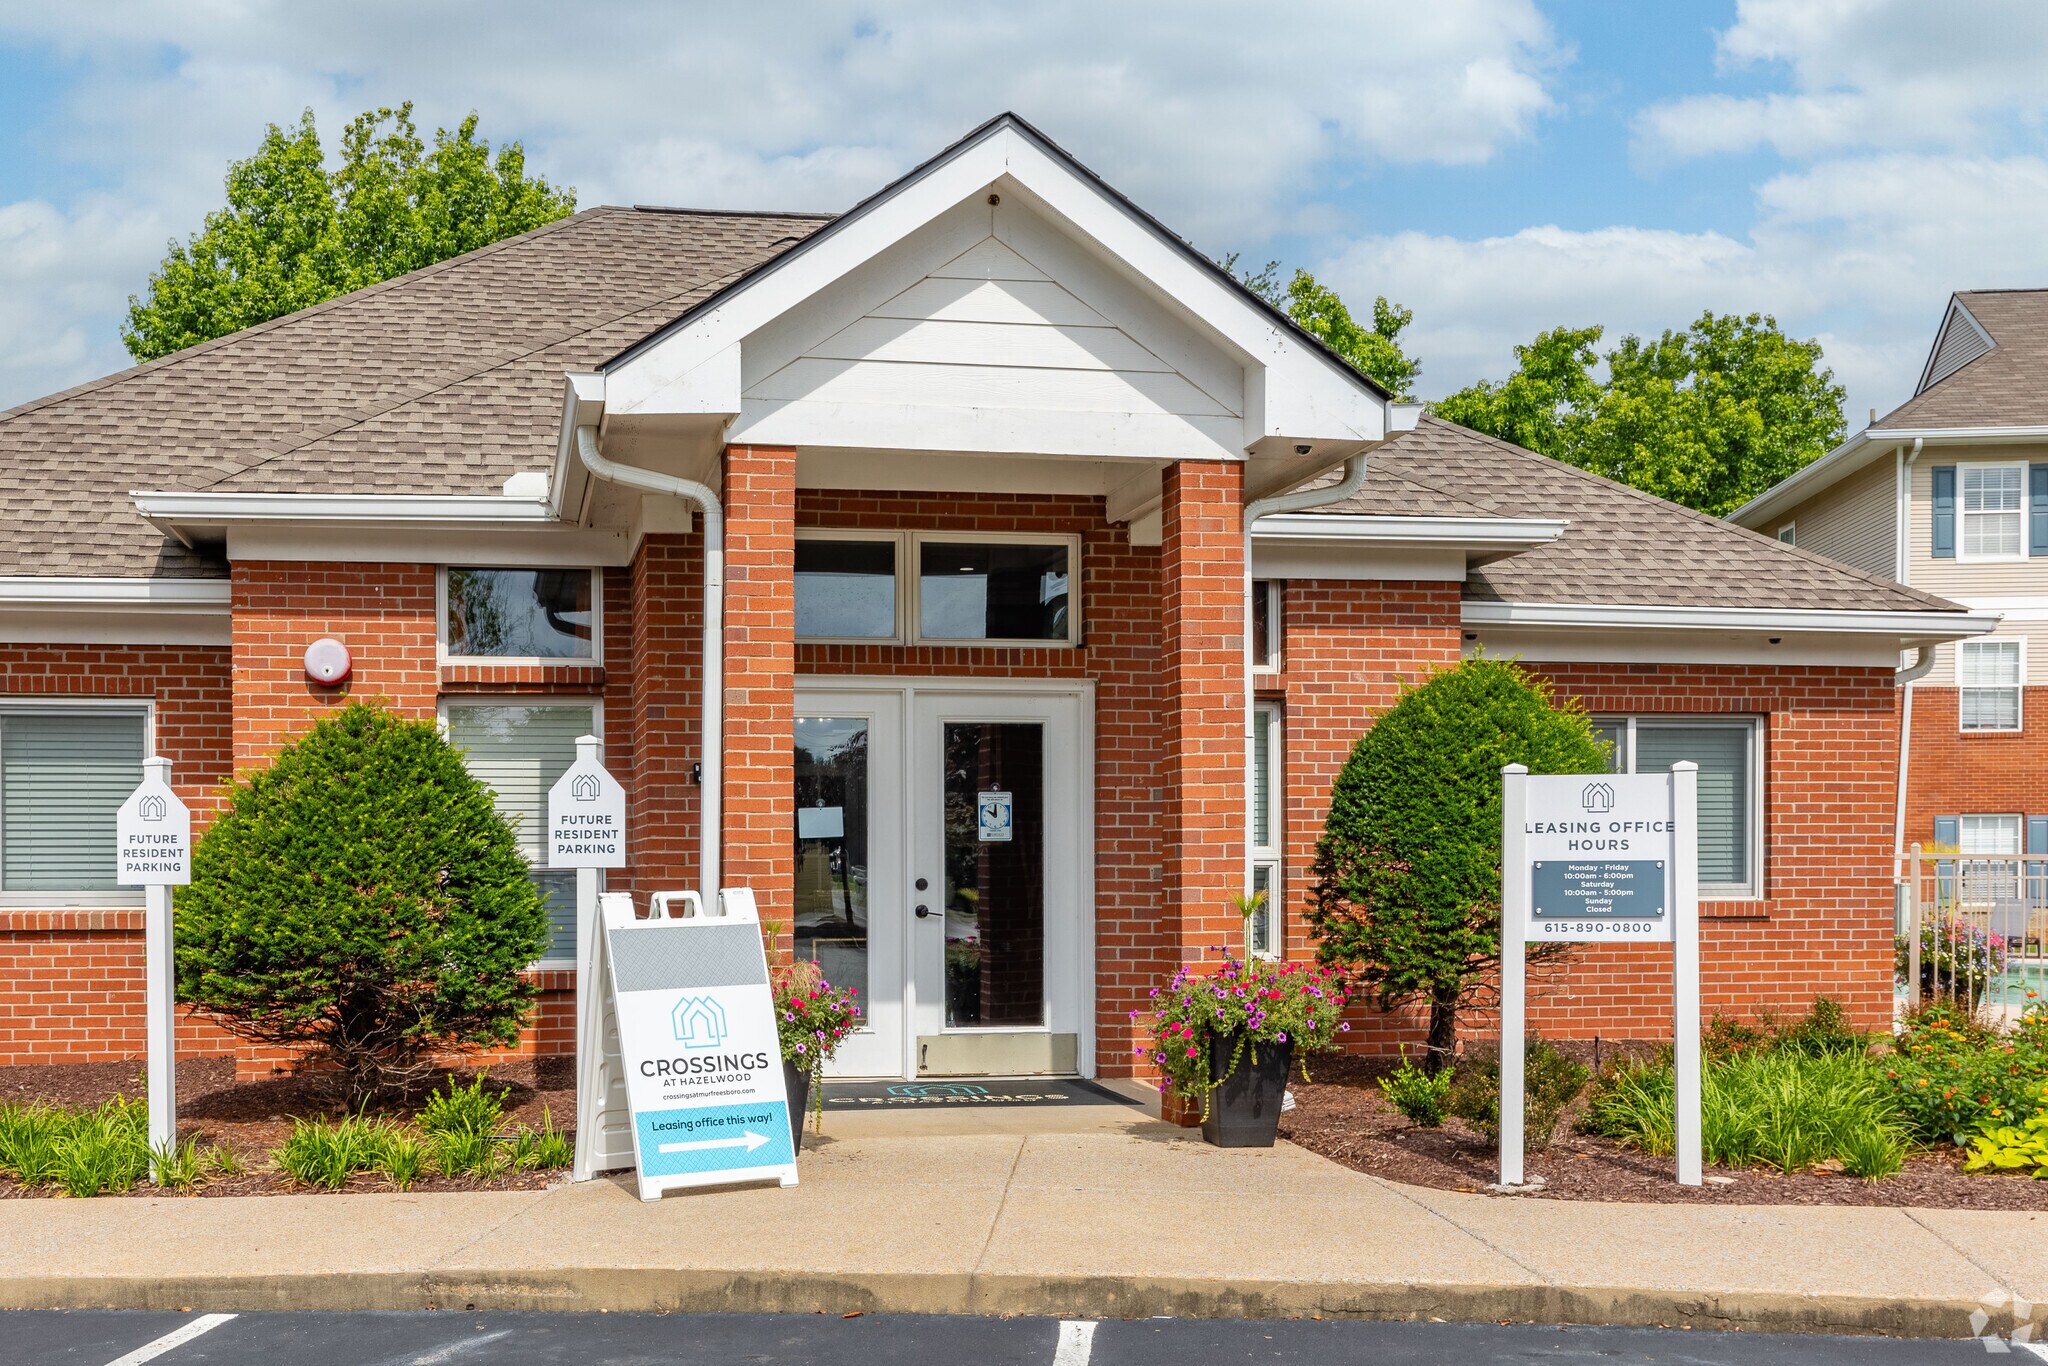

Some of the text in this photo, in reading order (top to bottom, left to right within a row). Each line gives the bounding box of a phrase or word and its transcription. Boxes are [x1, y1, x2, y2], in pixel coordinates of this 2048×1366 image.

[561, 815, 612, 825] FUTURE
[1525, 821, 1675, 834] LEASING OFFICE
[129, 834, 178, 844] FUTURE
[555, 830, 619, 839] RESIDENT
[558, 844, 616, 854] PARKING
[1568, 839, 1630, 851] HOURS
[123, 848, 184, 858] RESIDENT
[126, 862, 181, 872] PARKING
[1568, 864, 1599, 873] Monday
[1604, 864, 1630, 873] Friday
[1563, 872, 1597, 880] 10:00am
[1603, 872, 1634, 881] 6:00pm
[1580, 880, 1615, 890] Saturday
[1563, 889, 1597, 897] 10:00am
[1603, 889, 1634, 898] 5:00pm
[1584, 897, 1613, 907] Sunday
[1544, 923, 1652, 933] 615-890-0800
[640, 1052, 769, 1077] CROSSINGS
[663, 1073, 752, 1087] AT HAZELWOOD
[662, 1087, 756, 1101] crossingsatmurfreesboro.com
[652, 1112, 773, 1132] Leasing office this way!
